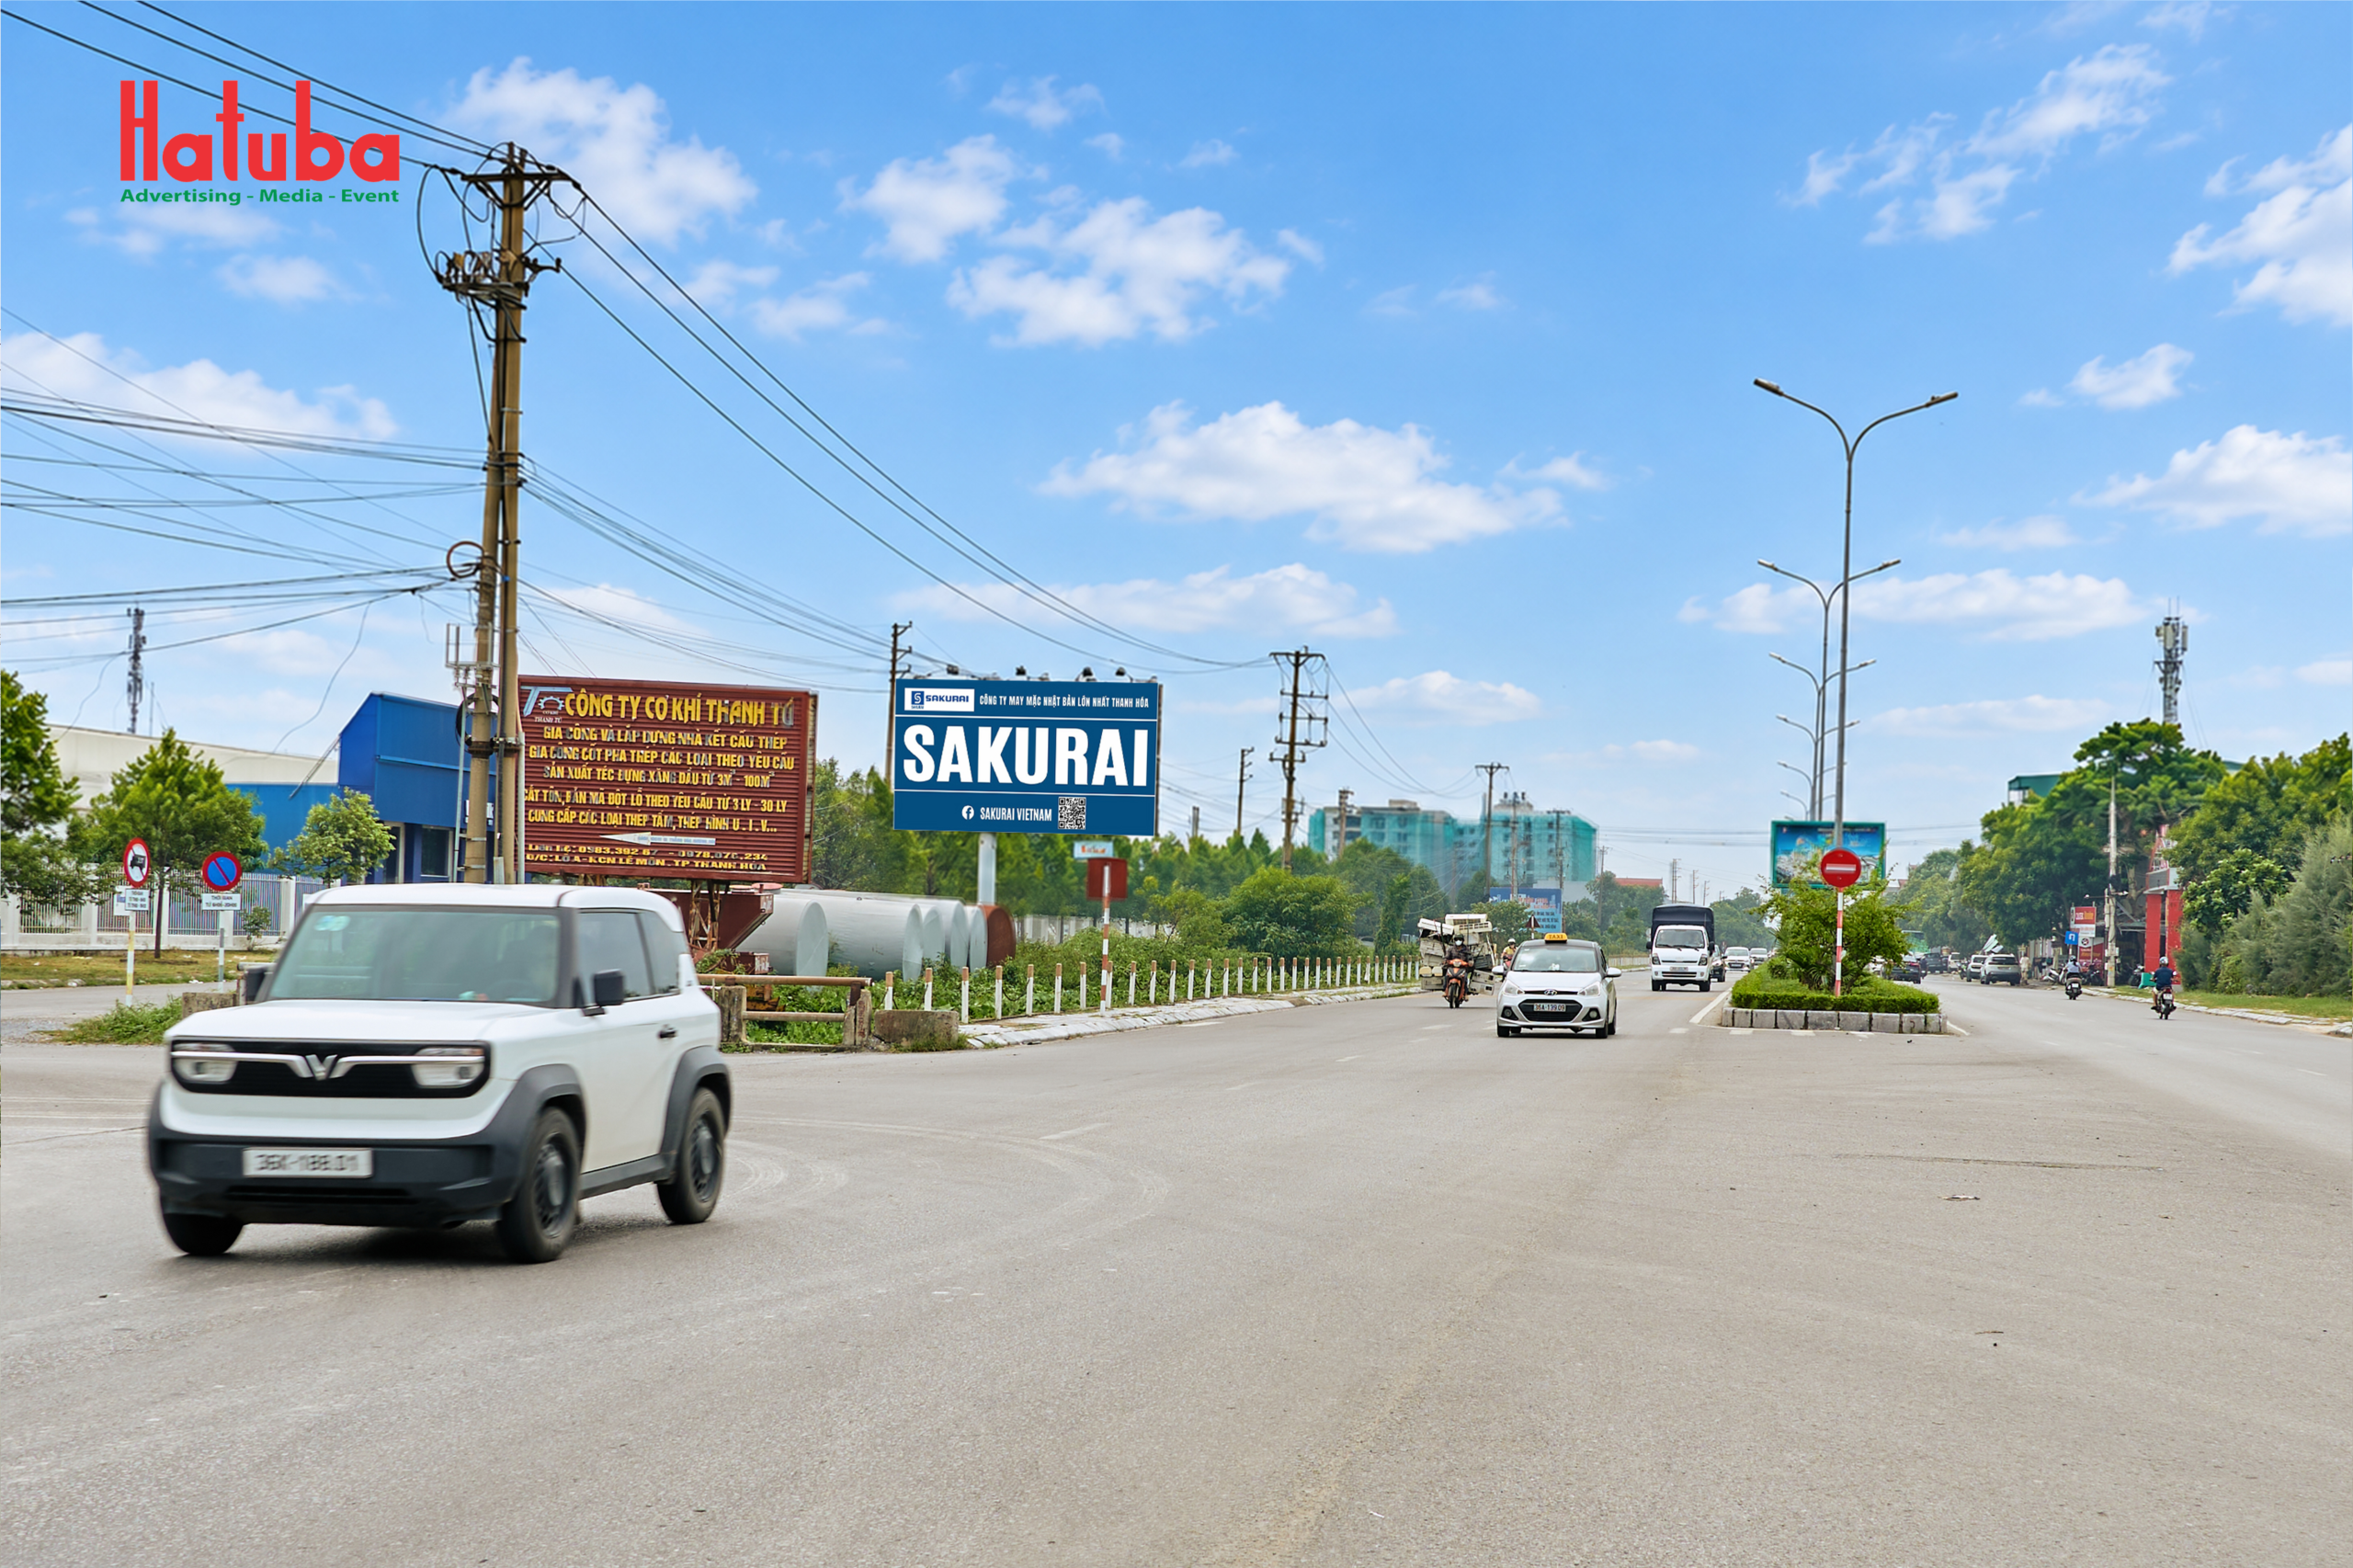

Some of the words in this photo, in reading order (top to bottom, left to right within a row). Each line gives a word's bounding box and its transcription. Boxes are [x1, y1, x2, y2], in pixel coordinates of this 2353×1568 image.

[565, 687, 613, 717] CÔNG
[618, 695, 642, 721] TY
[645, 695, 669, 721] CƠ
[672, 692, 702, 723] KHÍ
[706, 699, 765, 726] THANH
[979, 693, 997, 706] CÔNG
[999, 696, 1006, 706] TY
[1008, 696, 1024, 706] MAY
[1026, 694, 1041, 708] MẶC
[1043, 694, 1060, 708] NHẬT
[1063, 694, 1075, 707] BẢN
[1077, 695, 1090, 707] LỚN
[1092, 695, 1109, 708] NHẤT
[1111, 698, 1133, 708] THANH
[1135, 696, 1149, 708] HÓA
[543, 726, 563, 740] GIA
[565, 723, 597, 741] CÔNG
[600, 724, 615, 742] VÀ
[677, 728, 702, 745] NHÀ
[705, 728, 726, 746] KẾT
[757, 732, 788, 749] THÉP
[529, 745, 548, 758] GIA
[550, 742, 579, 759] CÔNG
[604, 749, 627, 762] PHA
[630, 745, 658, 764] THÉP
[661, 747, 682, 765] CÁC
[716, 754, 745, 767] THEO
[749, 750, 769, 768] YÊU
[904, 724, 1148, 787] SAKURAI
[645, 794, 669, 808] THEO
[733, 798, 738, 811] 3
[741, 799, 752, 812] LY
[760, 800, 773, 812] 30
[776, 800, 788, 812] LY
[528, 809, 554, 823] CUNG
[980, 807, 1015, 821] SAKURAI
[1017, 808, 1052, 822] VIETNAM
[693, 860, 737, 869] THANH
